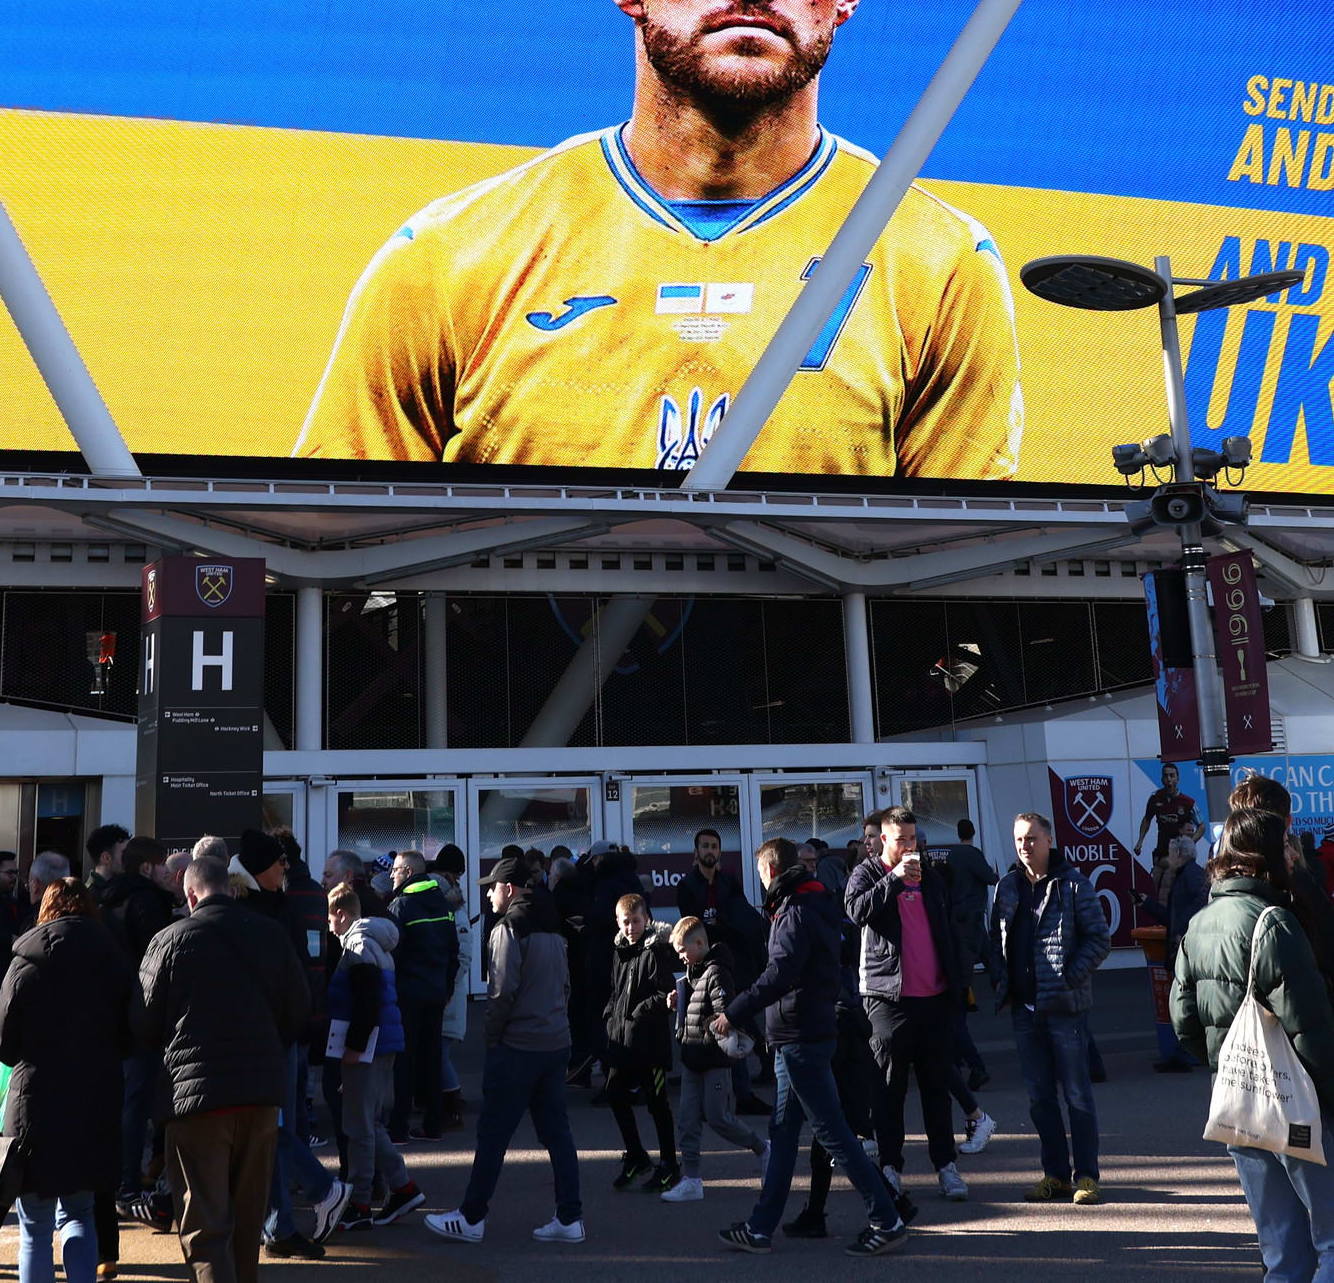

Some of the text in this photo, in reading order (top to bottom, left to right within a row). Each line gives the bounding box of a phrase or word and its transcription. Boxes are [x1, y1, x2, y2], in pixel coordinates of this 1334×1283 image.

[1204, 235, 1330, 307] AND
[192, 631, 234, 691] H
[1090, 778, 1108, 786] HAM
[607, 790, 619, 799] 12
[1064, 843, 1119, 862] NOBLE
[651, 869, 687, 887] blo
